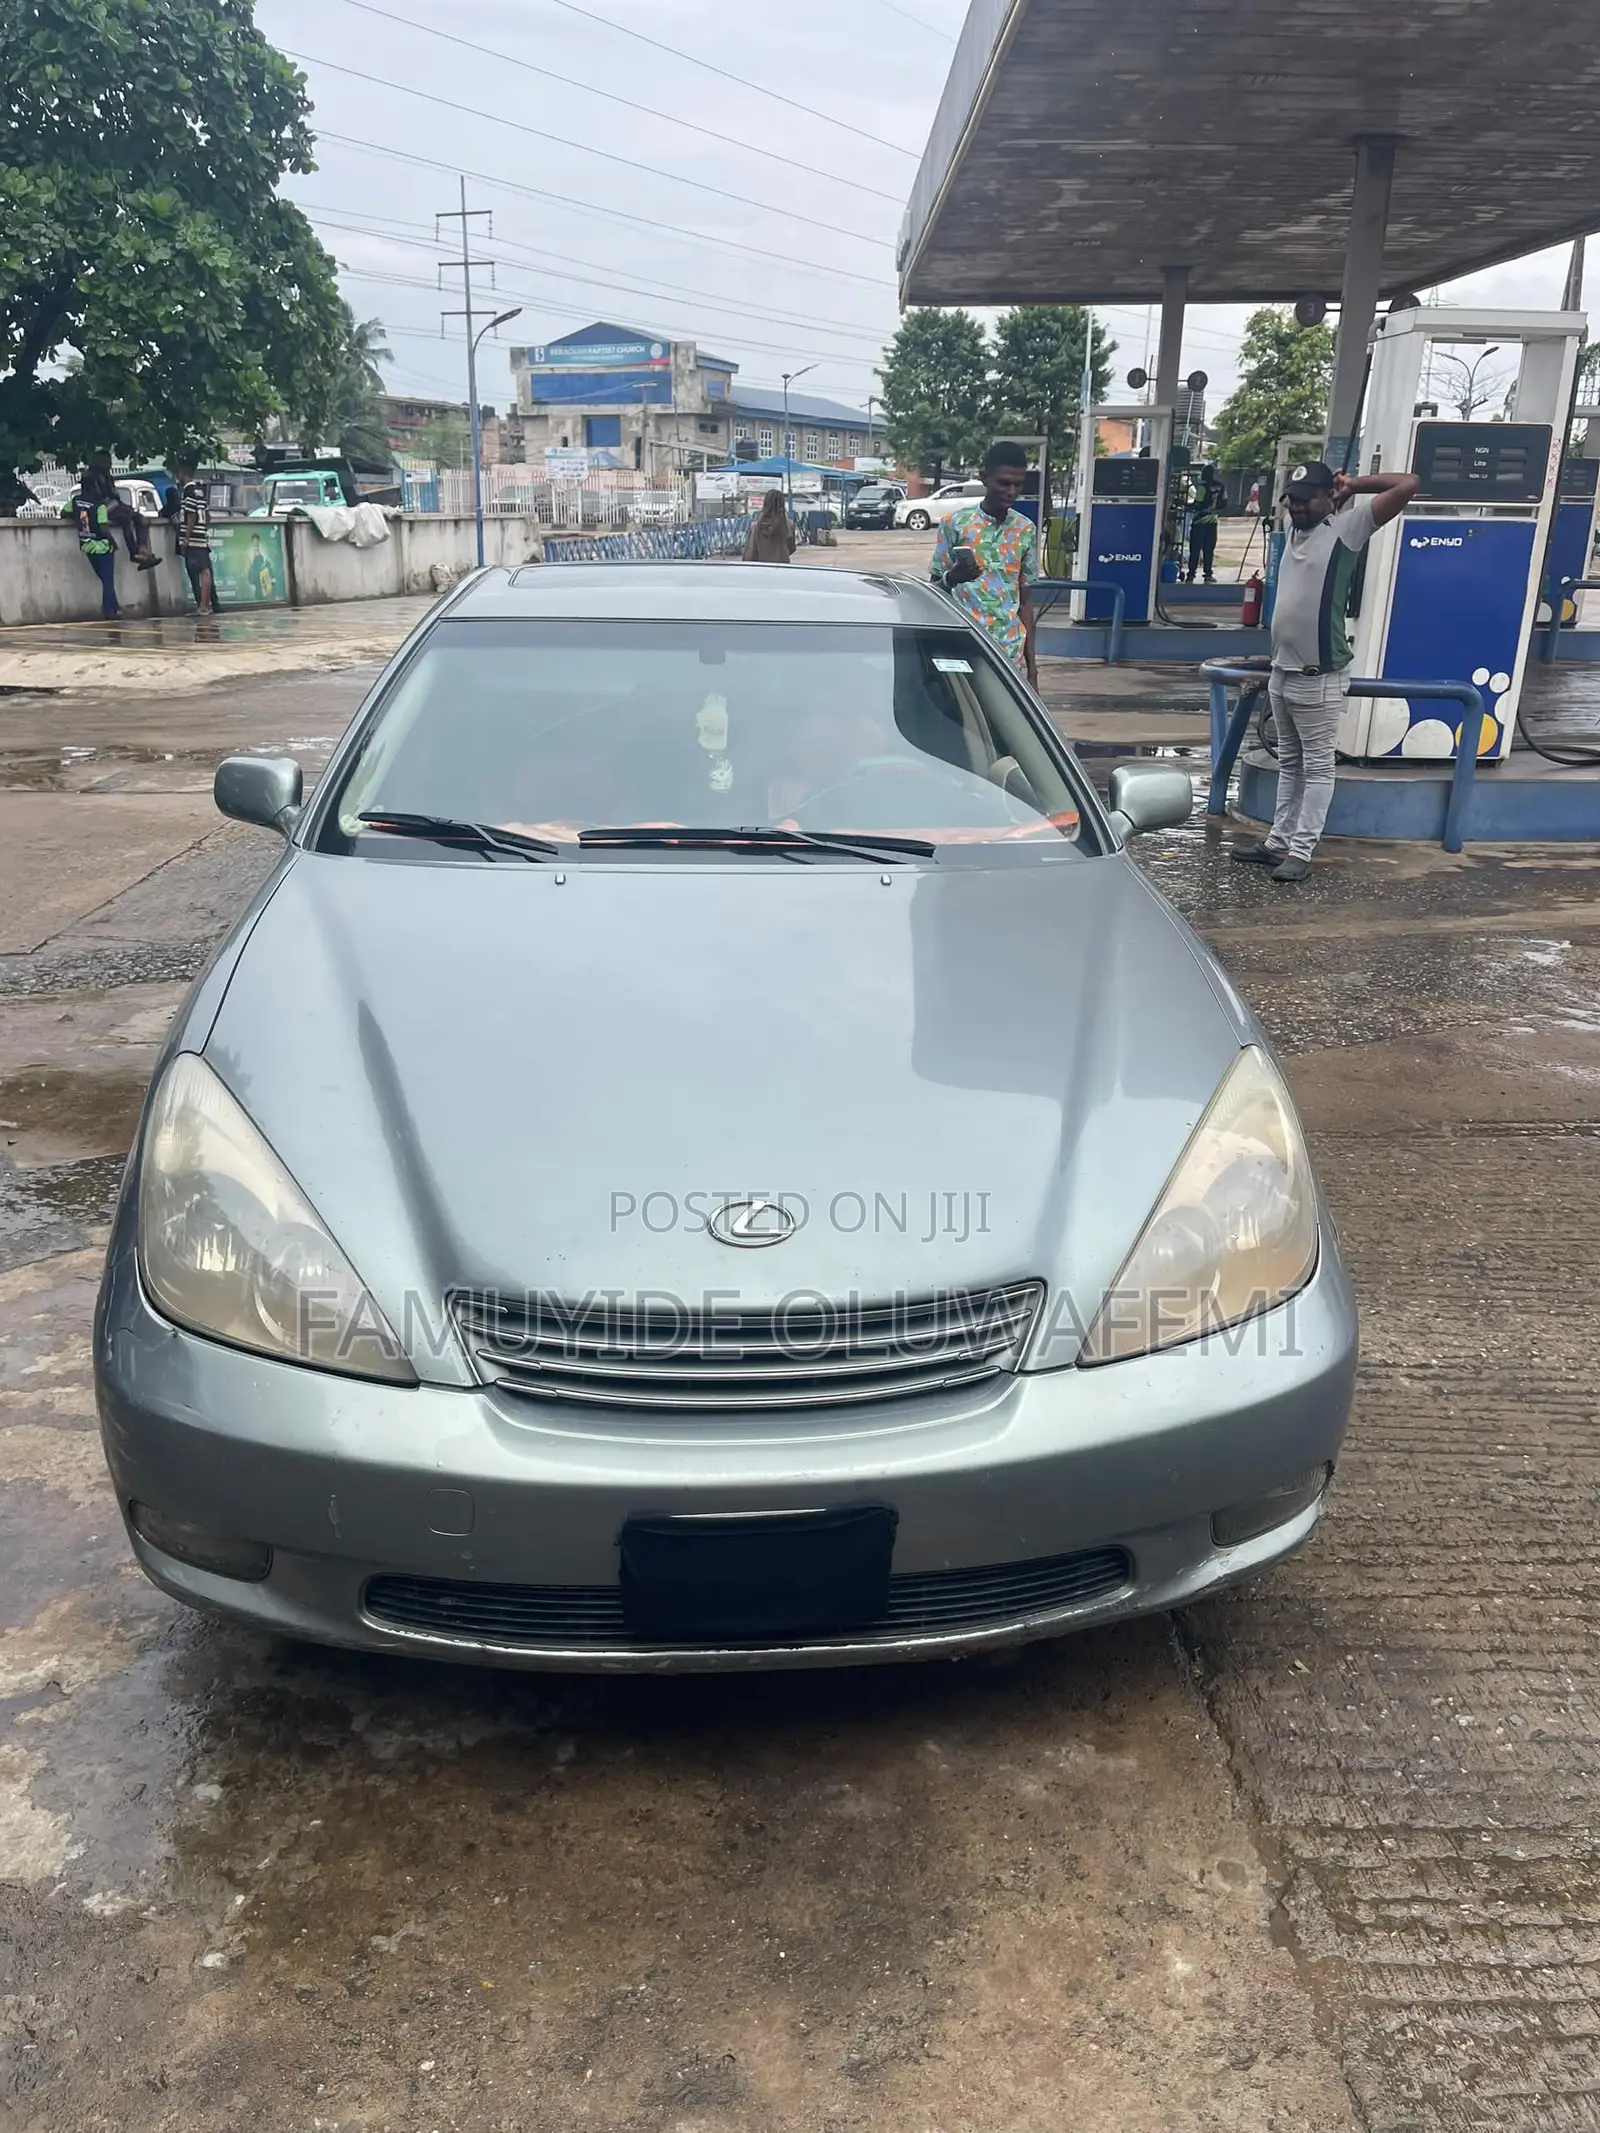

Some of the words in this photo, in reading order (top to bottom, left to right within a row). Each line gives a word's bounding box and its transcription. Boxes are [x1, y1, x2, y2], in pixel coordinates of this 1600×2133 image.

[1306, 302, 1316, 318] 3
[588, 346, 615, 355] BAPTIST
[616, 345, 646, 354] CHURCH
[1474, 446, 1490, 454] NGN
[1430, 537, 1463, 547] ENYO
[1115, 553, 1142, 562] ENYO
